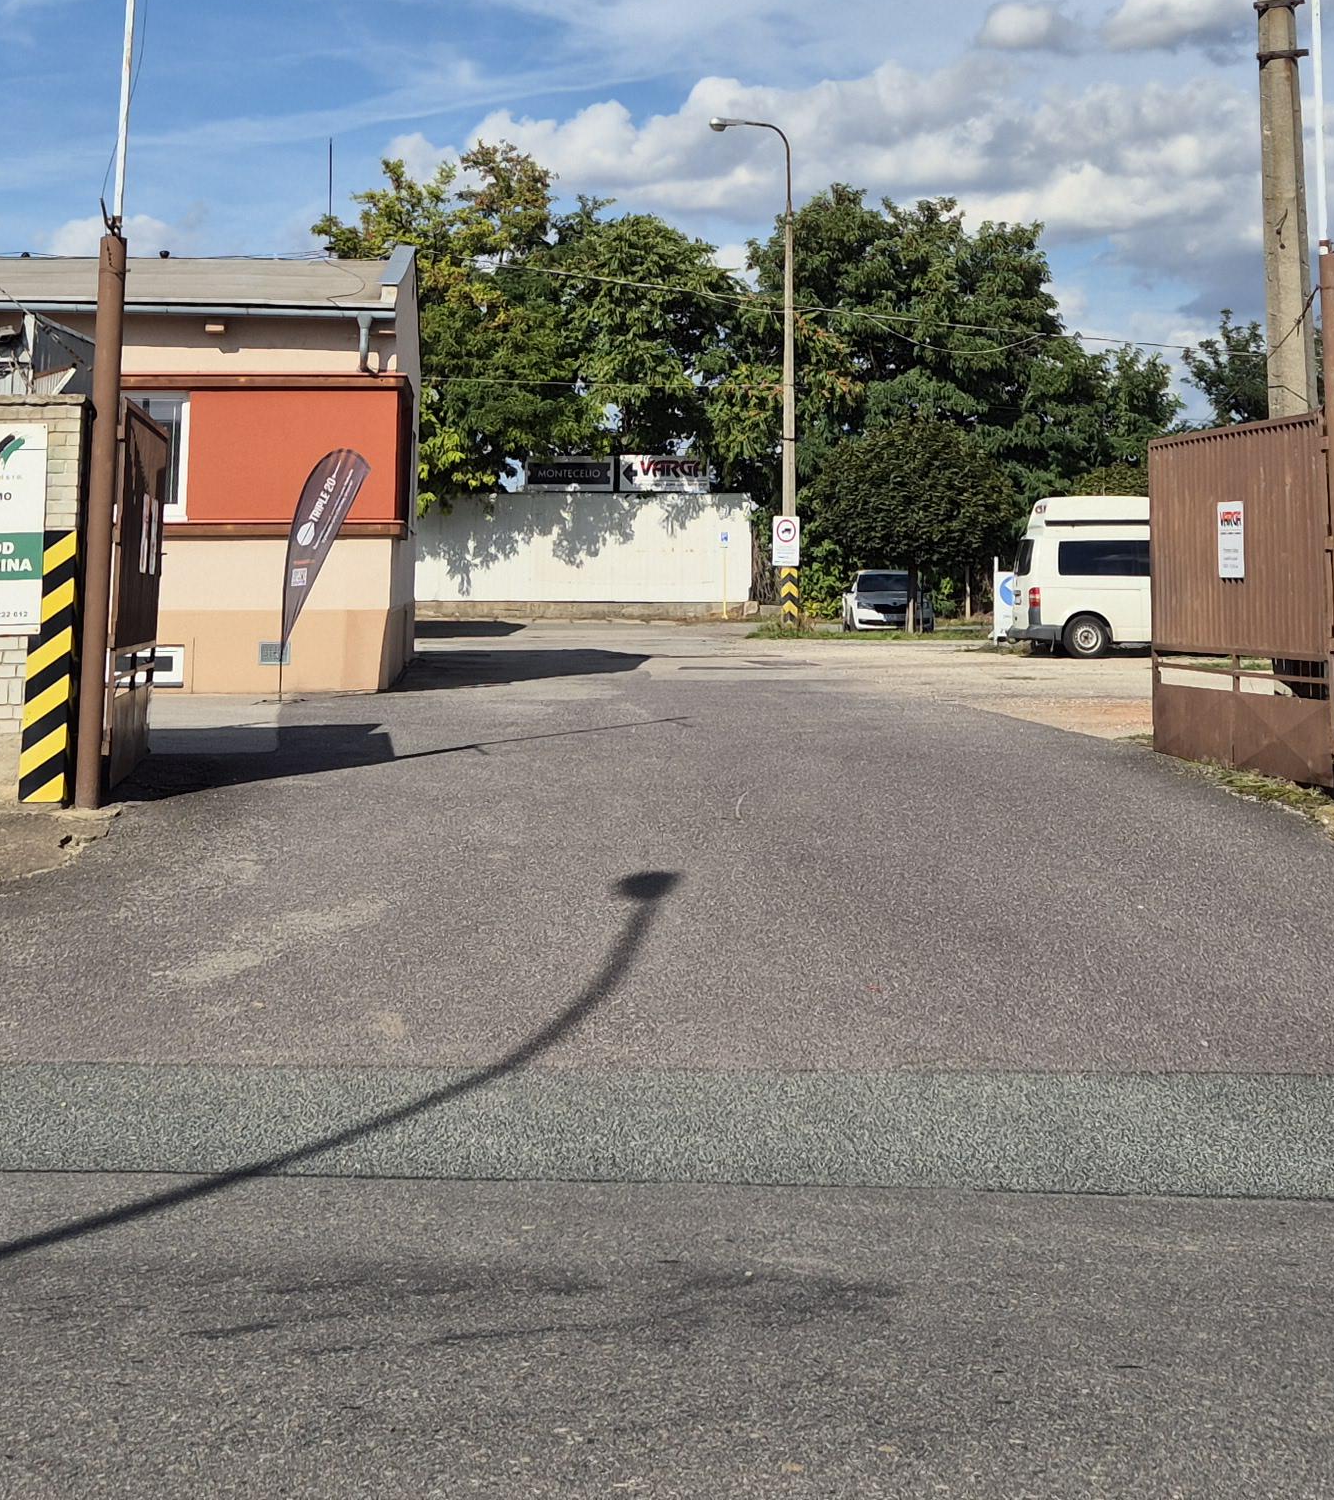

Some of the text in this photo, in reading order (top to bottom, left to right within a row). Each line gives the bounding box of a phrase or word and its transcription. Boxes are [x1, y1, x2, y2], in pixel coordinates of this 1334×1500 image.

[537, 468, 601, 479] MONTECELIO
[640, 458, 707, 478] VARGA
[308, 490, 331, 523] TRIPLE
[324, 477, 337, 493] 20
